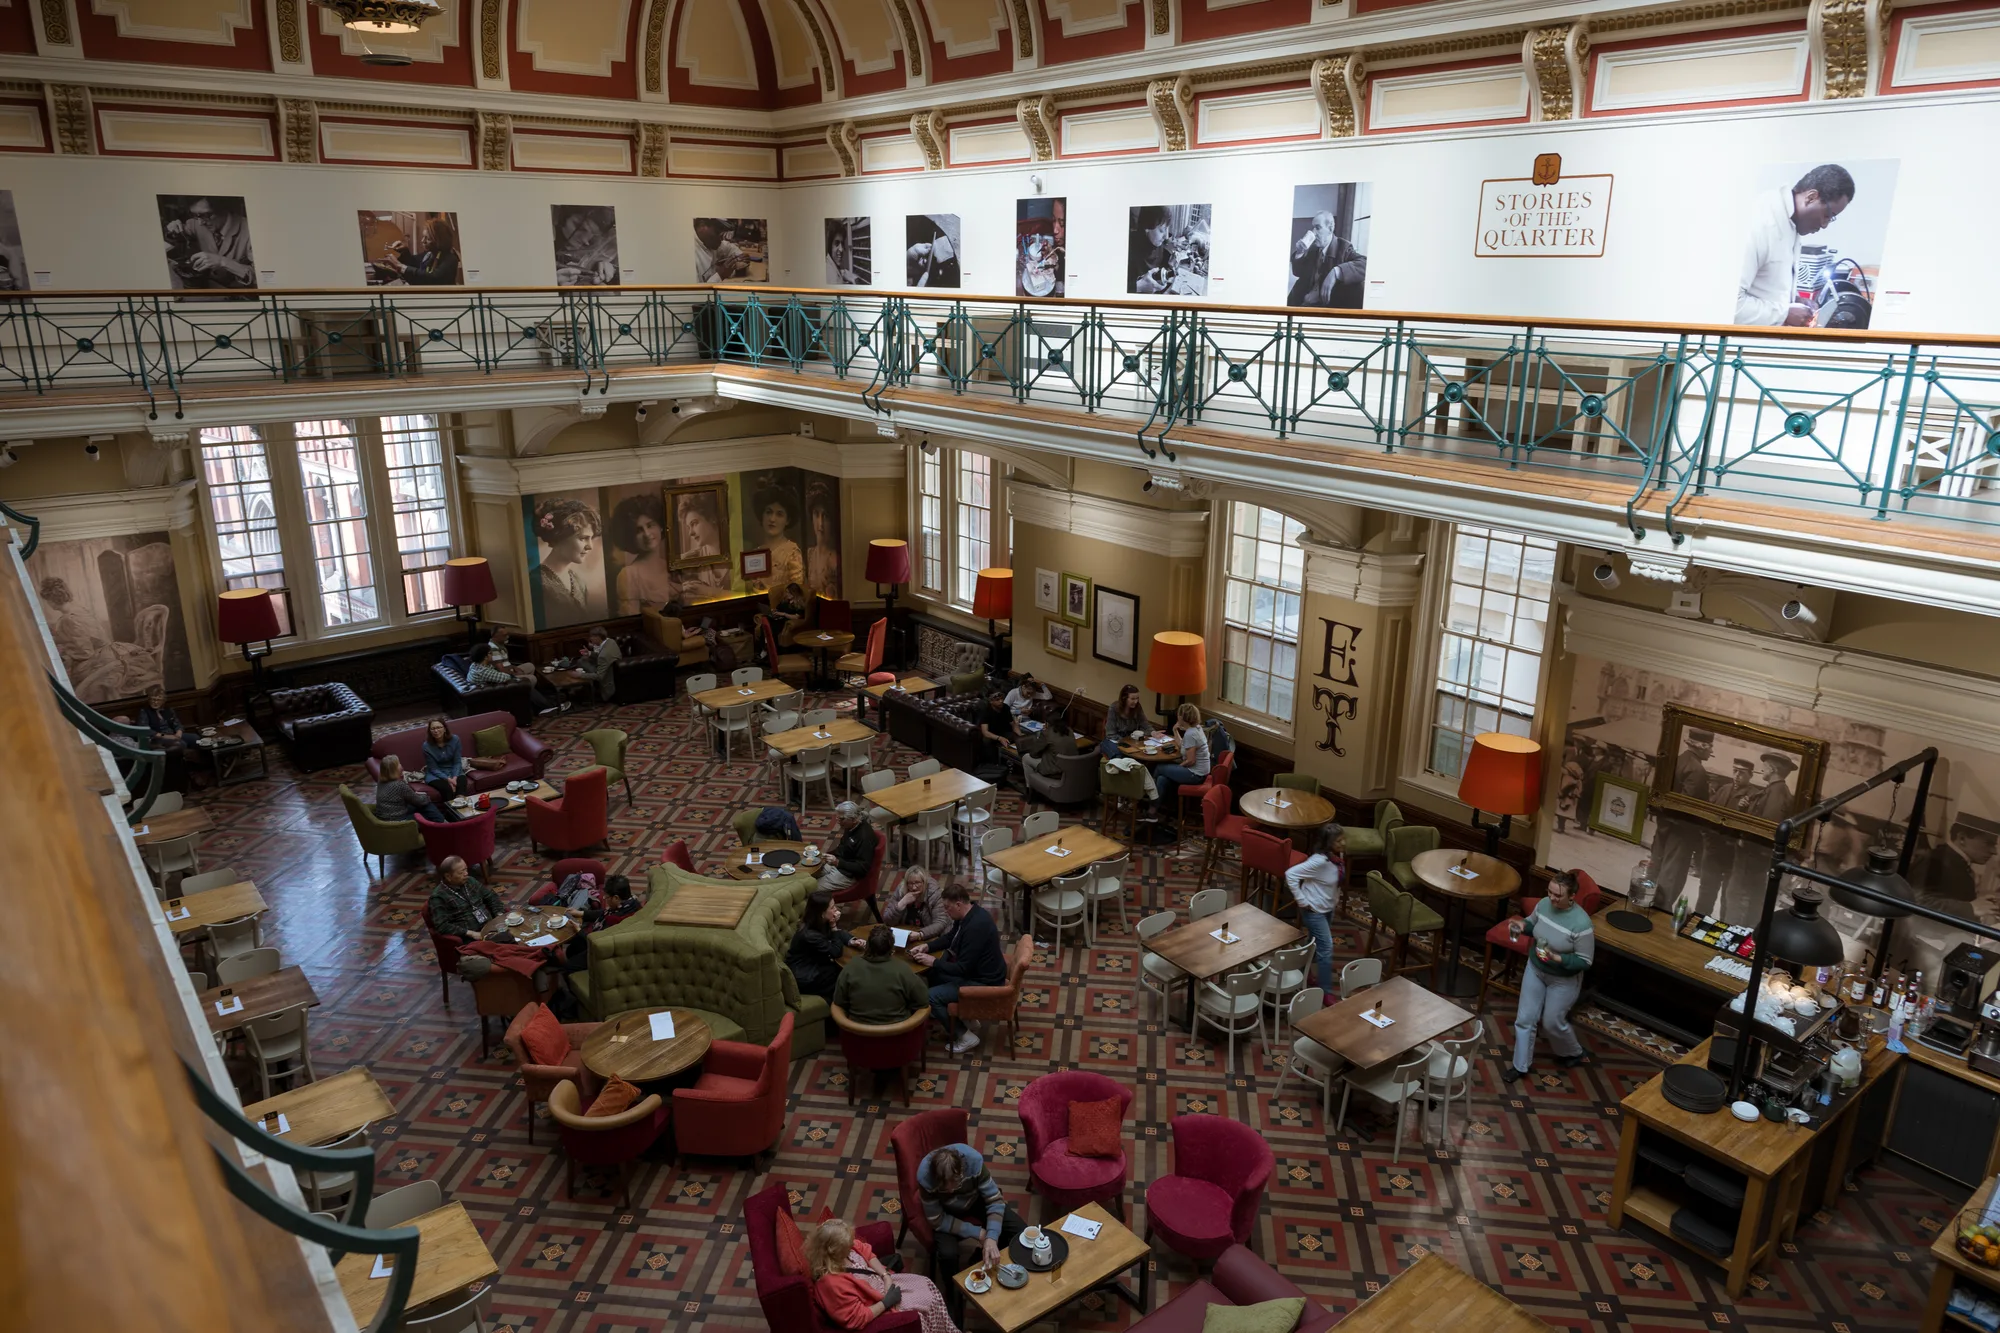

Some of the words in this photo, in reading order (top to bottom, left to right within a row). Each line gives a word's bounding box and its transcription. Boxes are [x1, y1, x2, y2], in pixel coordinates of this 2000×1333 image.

[1495, 191, 1592, 211] STORIES
[1509, 212, 1533, 227] OF
[1536, 211, 1573, 226] THE
[1484, 228, 1596, 250] QUARTER
